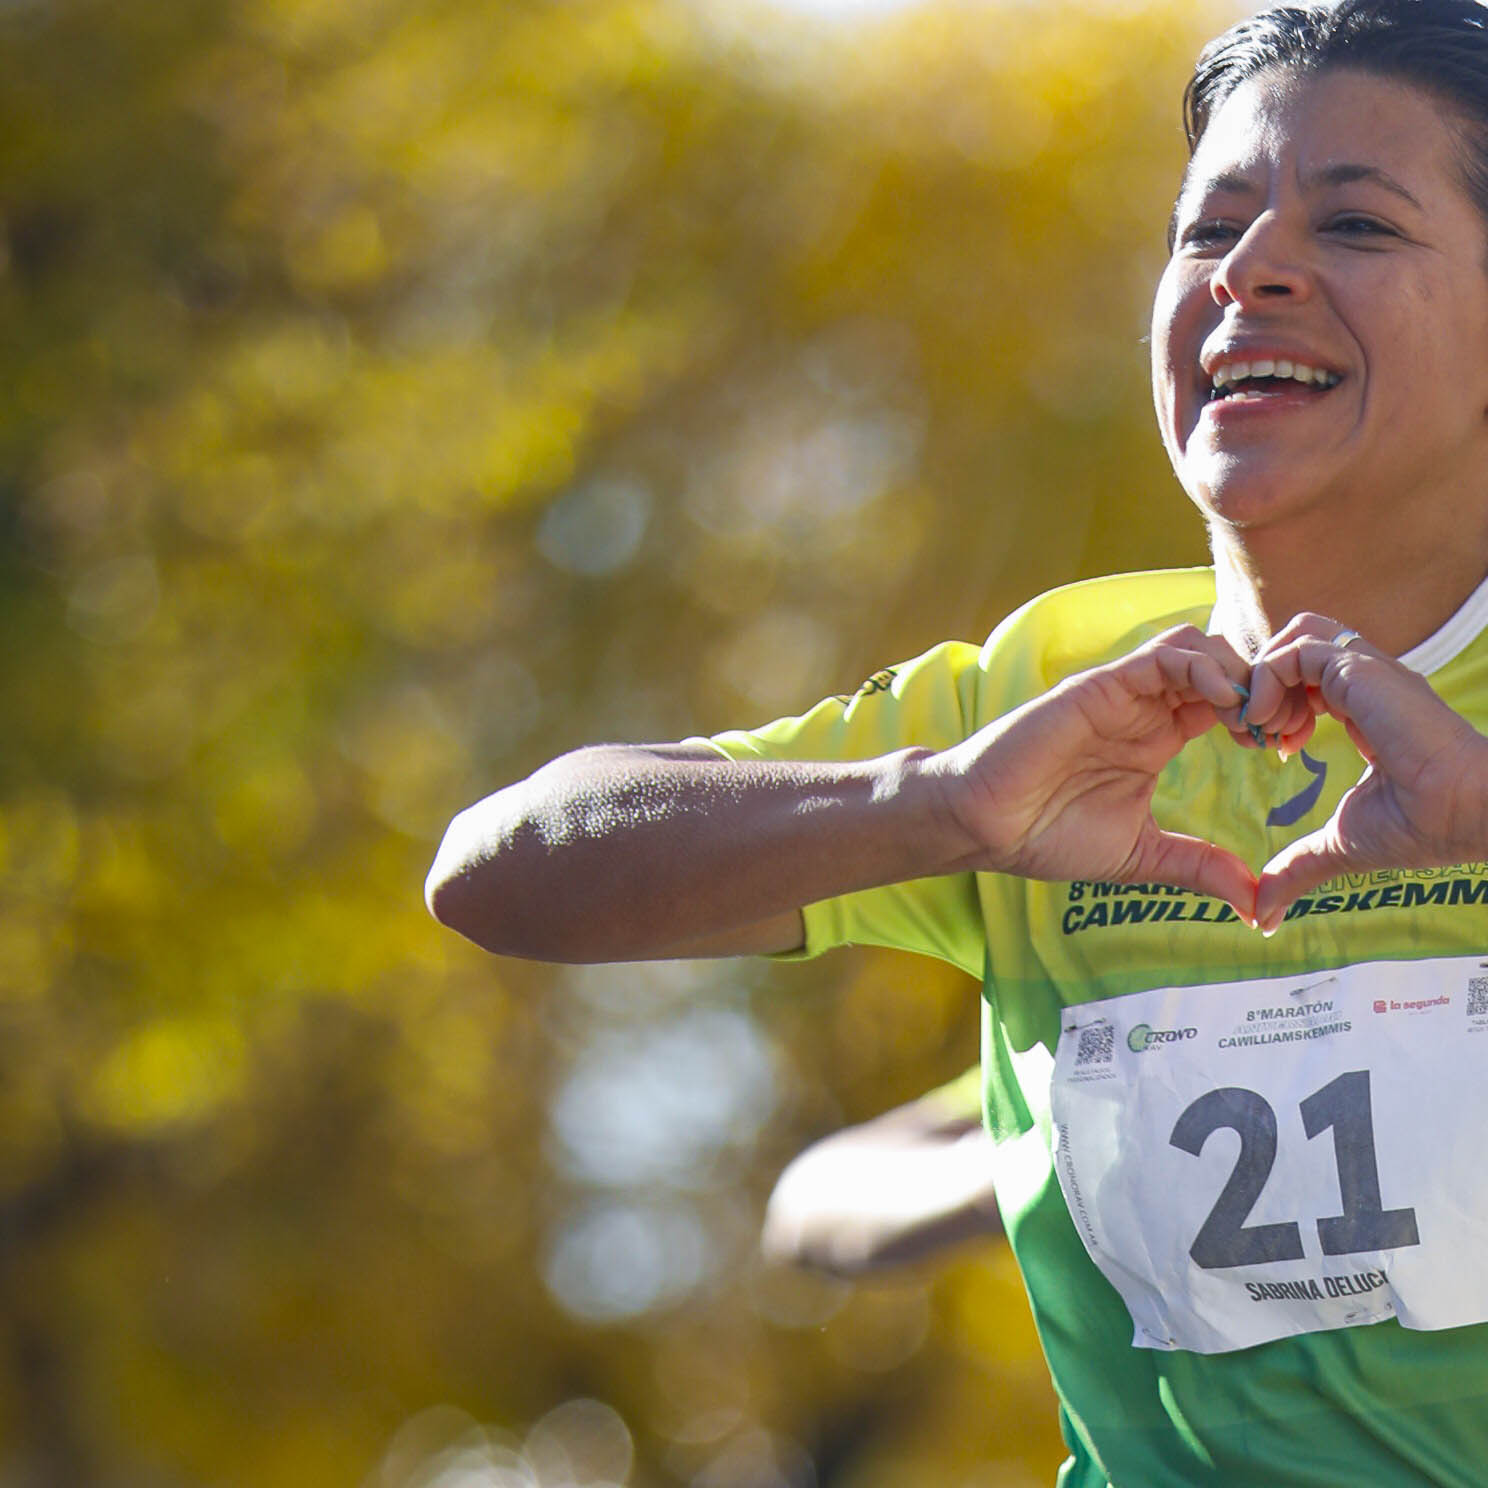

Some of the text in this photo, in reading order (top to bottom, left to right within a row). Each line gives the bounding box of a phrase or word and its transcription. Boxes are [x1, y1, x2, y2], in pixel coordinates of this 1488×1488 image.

[1218, 1020, 1352, 1049] CAWILLIAMSKEMMIS
[1169, 1069, 1420, 1269] 21
[1245, 1279, 1324, 1301] SABRINA
